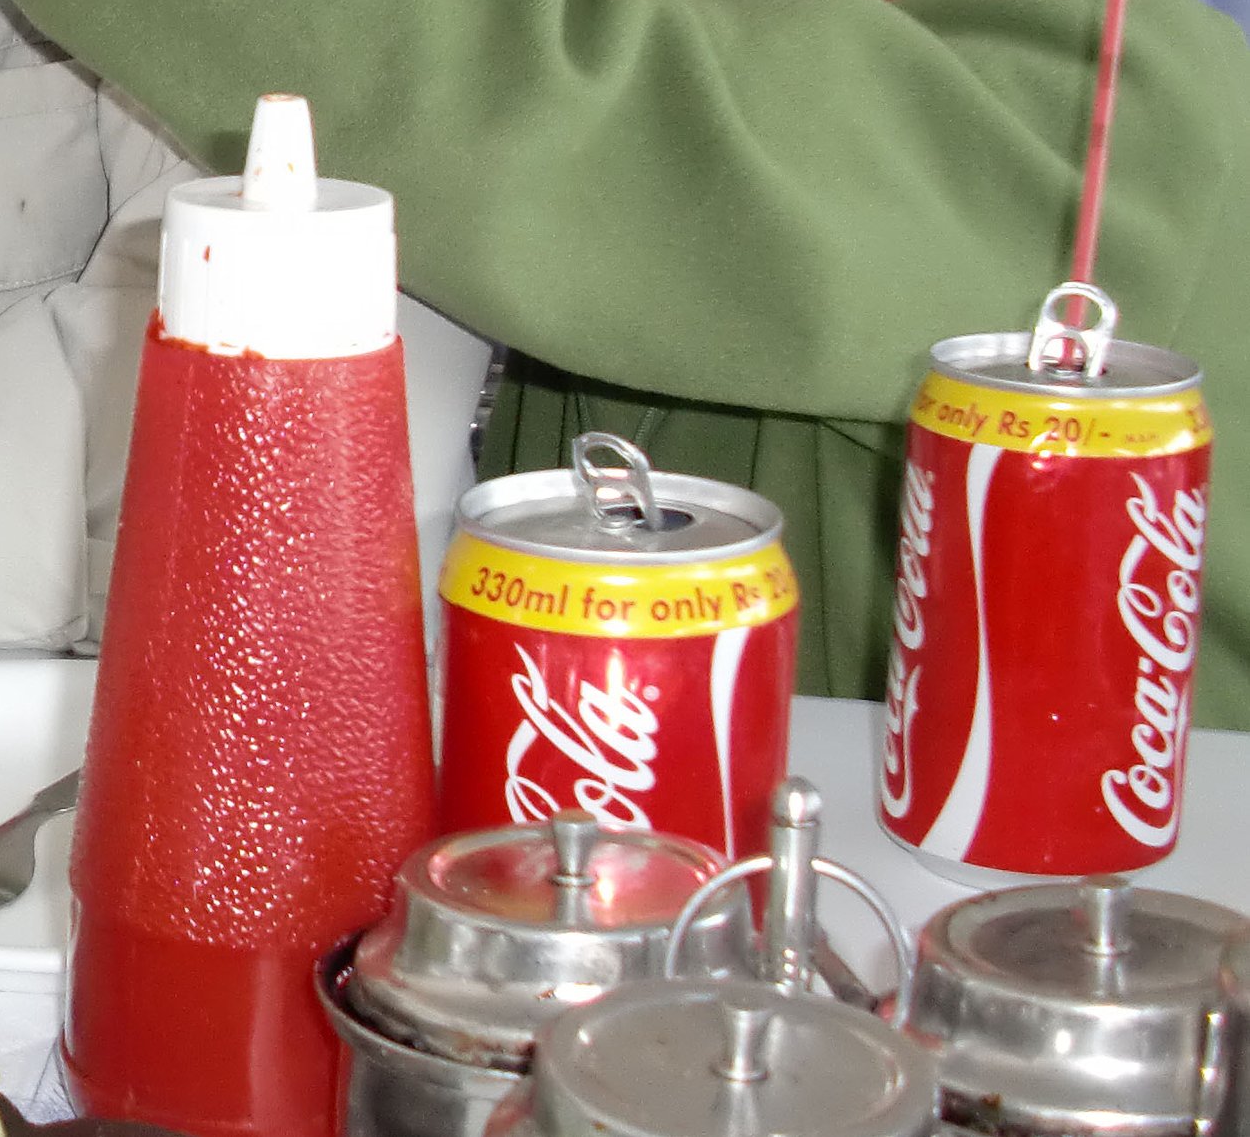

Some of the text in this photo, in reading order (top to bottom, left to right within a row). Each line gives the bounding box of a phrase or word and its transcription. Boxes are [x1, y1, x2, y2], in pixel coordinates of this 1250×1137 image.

[937, 402, 989, 437] only
[997, 409, 1031, 439] Rs
[470, 566, 569, 616] 330ml
[582, 586, 637, 621] for
[650, 585, 724, 622] only
